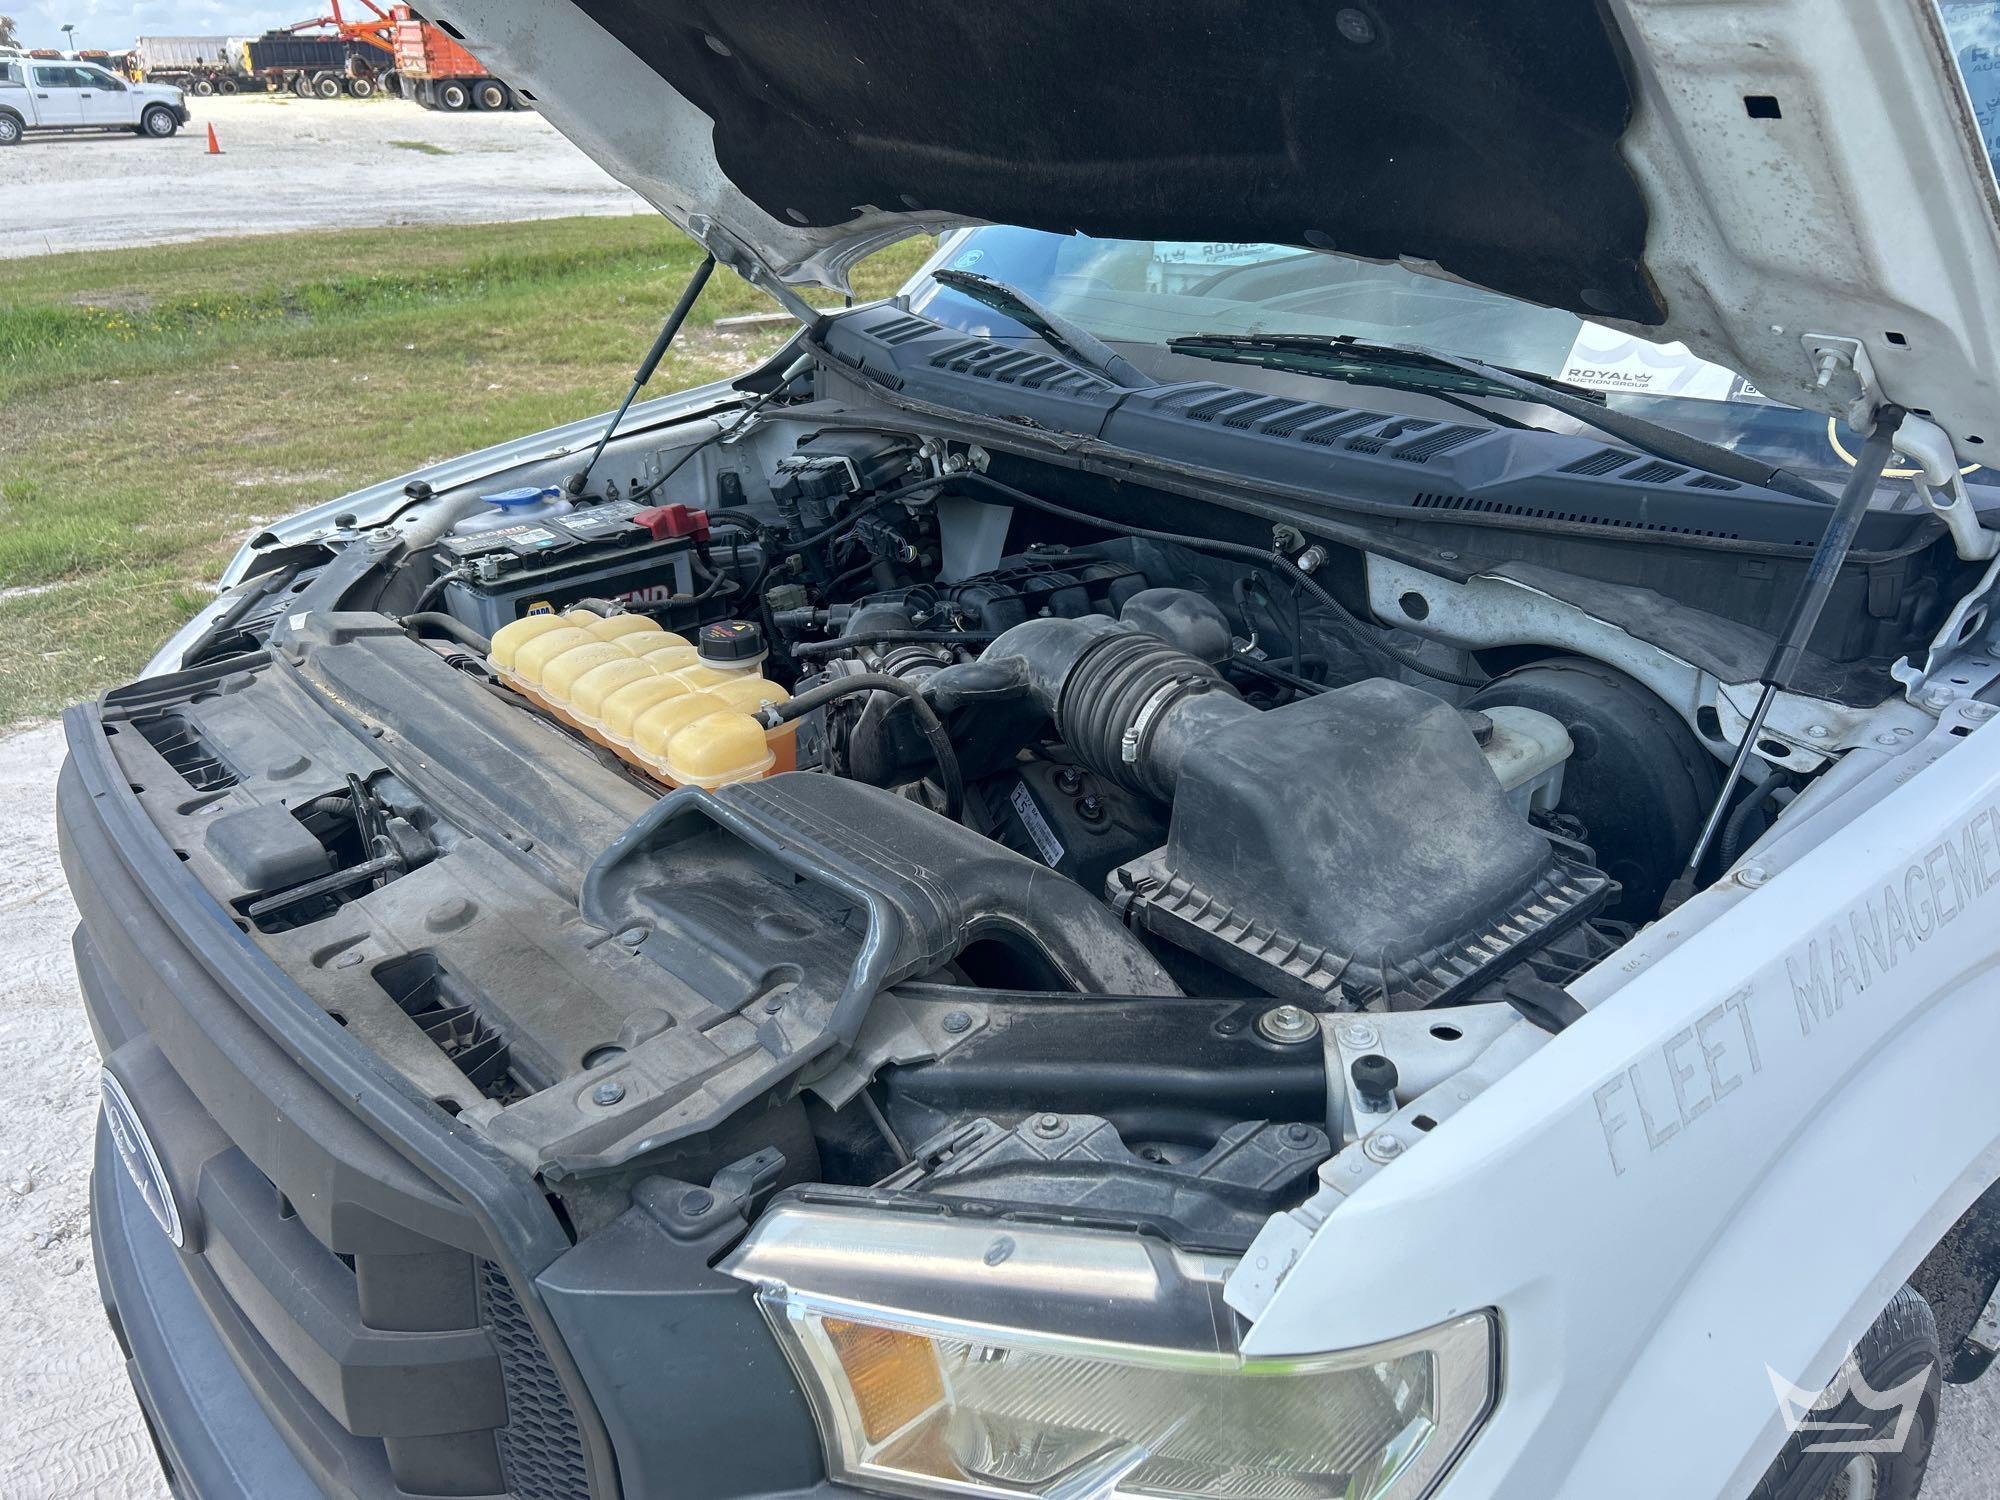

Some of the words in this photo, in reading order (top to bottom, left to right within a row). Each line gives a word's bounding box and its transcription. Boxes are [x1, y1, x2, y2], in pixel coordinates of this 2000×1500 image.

[1568, 368, 1633, 381] ROYAL
[1565, 377, 1611, 385] AUCTION
[1612, 380, 1649, 388] GROUP
[530, 606, 550, 616] NAPA
[1592, 984, 1762, 1177] FLEET
